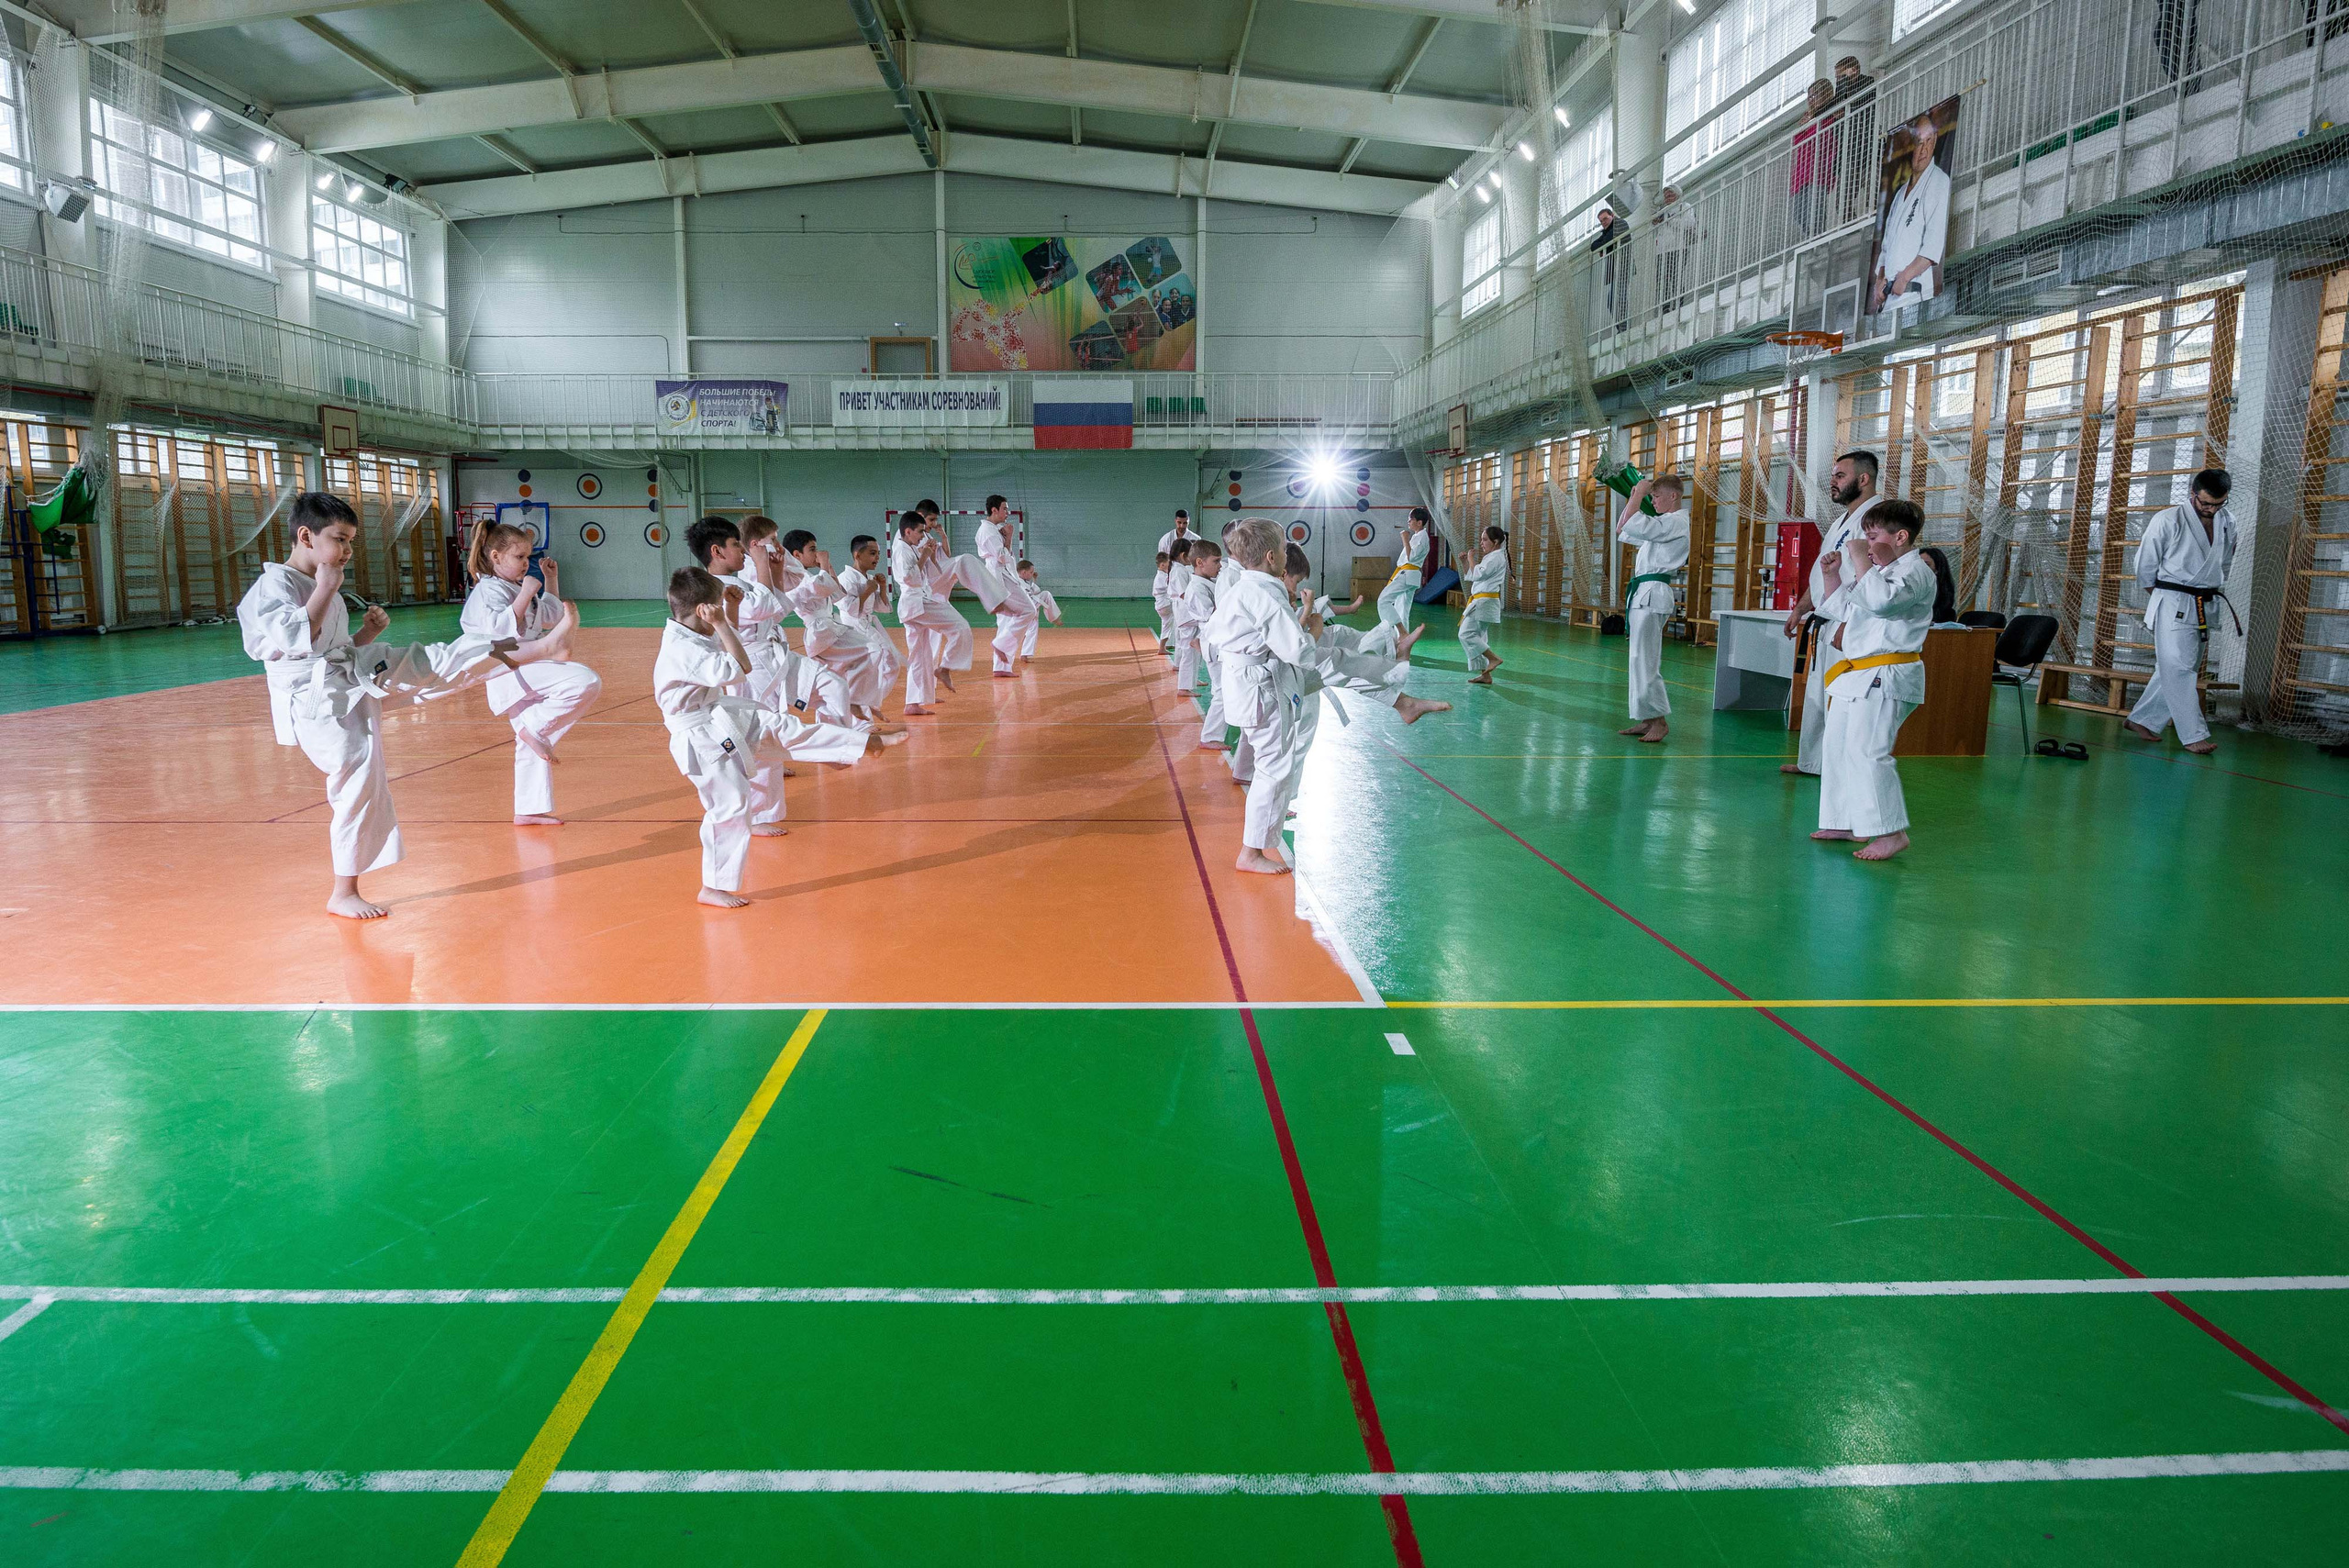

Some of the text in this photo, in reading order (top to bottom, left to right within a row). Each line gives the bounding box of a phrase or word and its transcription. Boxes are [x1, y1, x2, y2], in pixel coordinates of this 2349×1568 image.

[699, 388, 776, 396] БОЛЬШИЕ ПОБЕДЫ
[840, 386, 1001, 410] ПРИВЕТ УЧАСТНИКАМ СОРЕВНОВАНИЙ!
